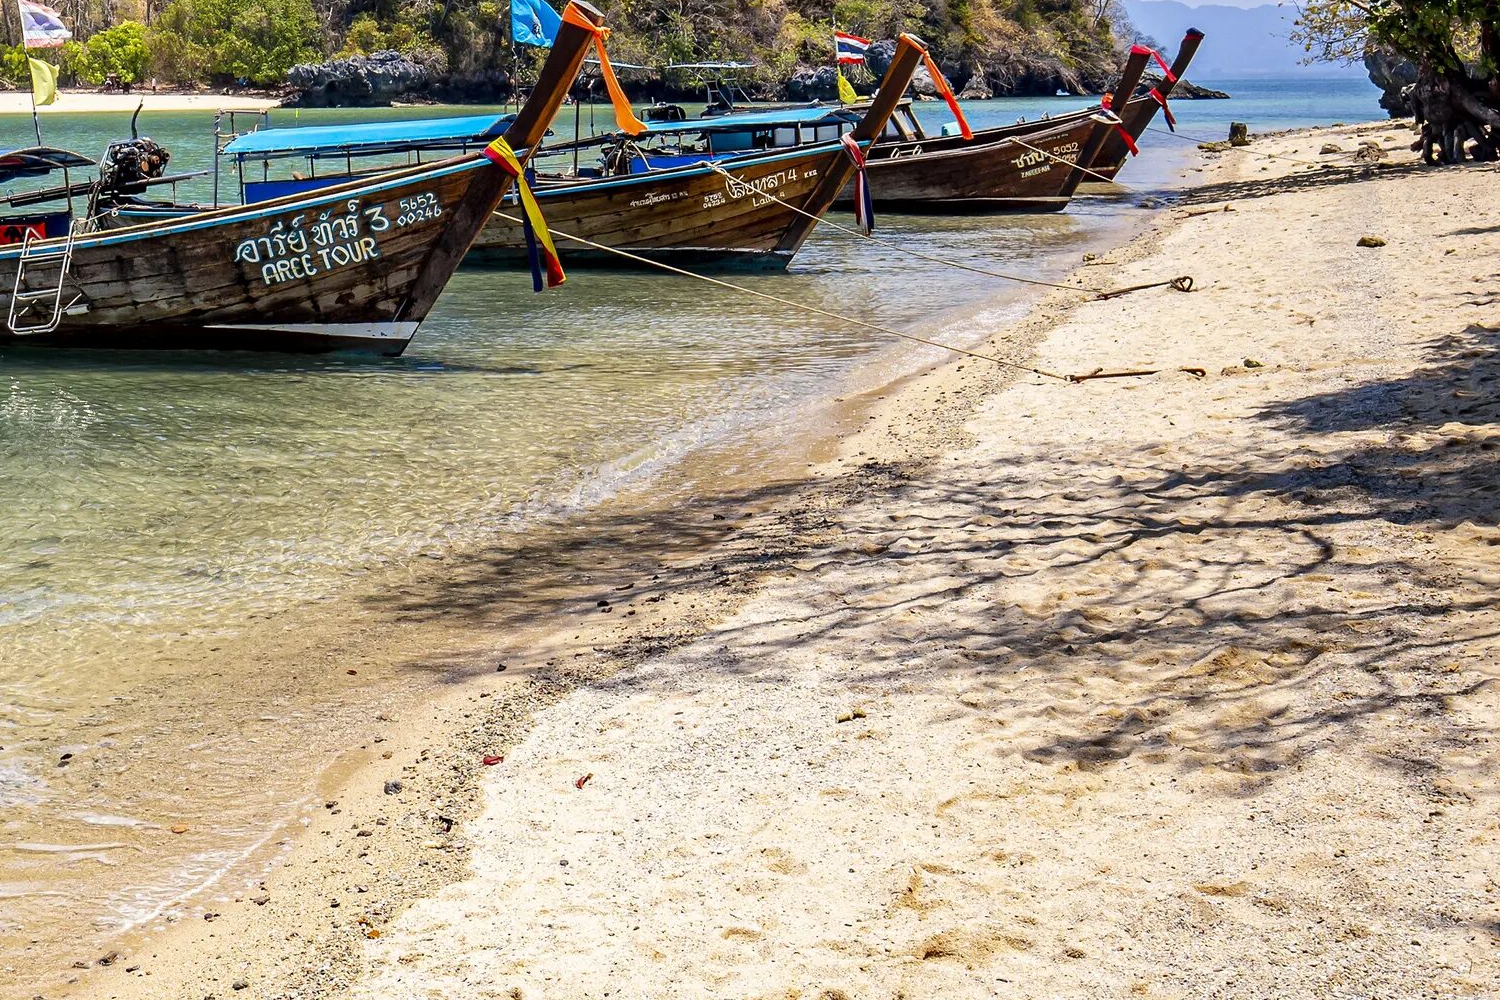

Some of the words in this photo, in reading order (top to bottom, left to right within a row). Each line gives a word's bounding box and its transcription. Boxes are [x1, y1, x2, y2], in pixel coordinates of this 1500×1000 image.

[399, 192, 437, 212] 5652
[365, 206, 390, 232] 3
[397, 204, 442, 227] 00246
[261, 253, 317, 285] AREE
[317, 237, 379, 270] TOUR
